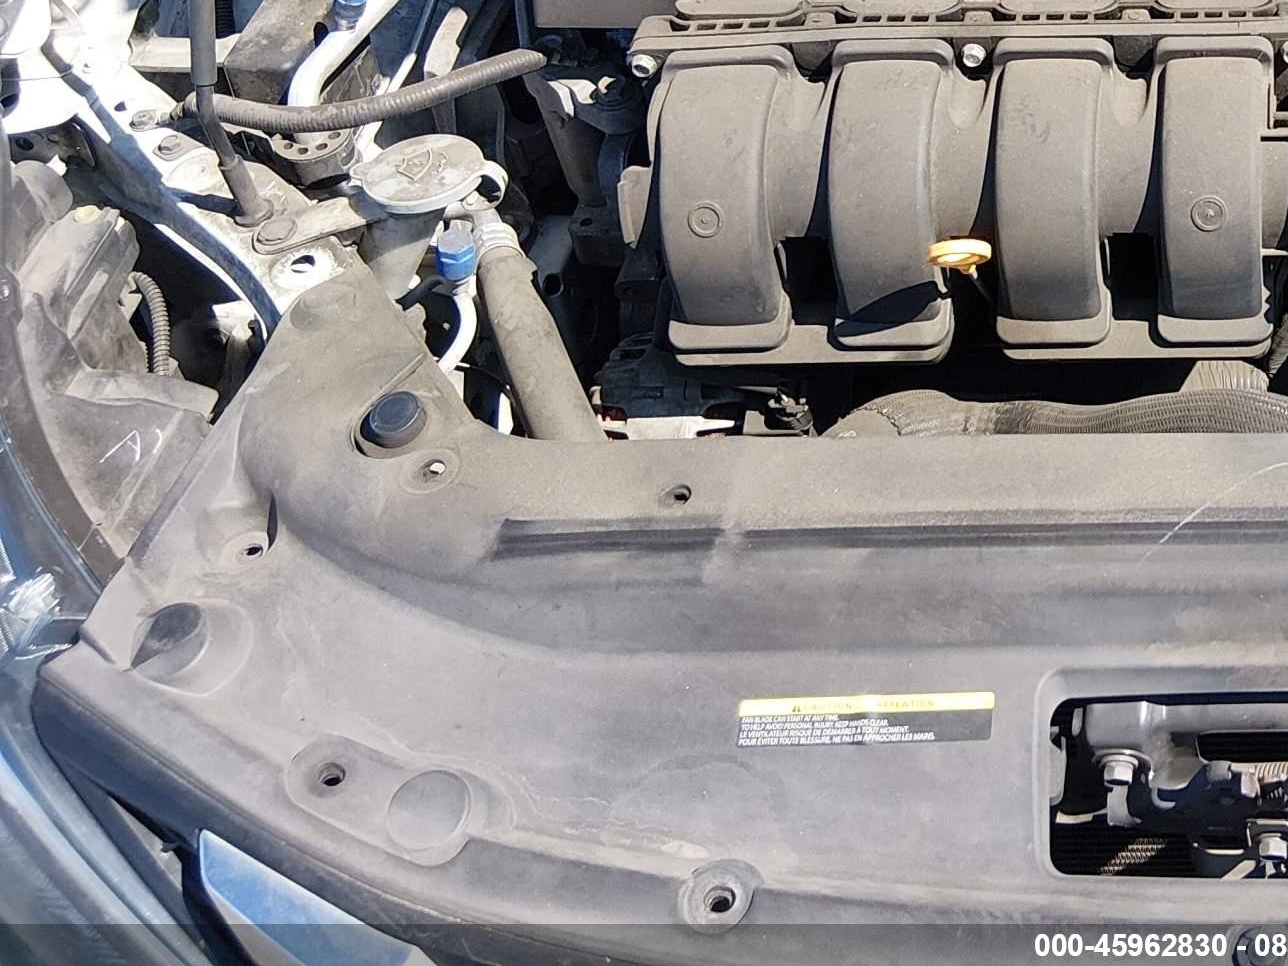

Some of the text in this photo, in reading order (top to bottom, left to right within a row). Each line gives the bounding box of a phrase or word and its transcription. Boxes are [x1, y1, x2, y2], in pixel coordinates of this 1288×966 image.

[876, 699, 934, 708] ATTENTION
[754, 715, 773, 723] BLADE
[773, 715, 787, 723] CAN
[786, 714, 804, 722] START
[803, 714, 813, 722] AT
[811, 713, 825, 721] ANY
[750, 723, 766, 731] HELP
[765, 722, 784, 730] AVOID
[783, 721, 813, 730] PERSONAL
[834, 720, 850, 728] KEEP
[848, 719, 869, 727] HANDS
[739, 731, 748, 739] LE
[748, 729, 789, 738] VENTILATEUR
[789, 728, 813, 737] RISQUE
[812, 728, 823, 736] DE
[861, 726, 880, 734] TOUT
[738, 738, 758, 747] POUR
[778, 736, 801, 745] TOUTE
[832, 735, 843, 744] NE
[842, 734, 854, 743] PAS
[853, 733, 863, 742] EN
[863, 733, 902, 742] APPROCHER
[901, 733, 913, 741] LES
